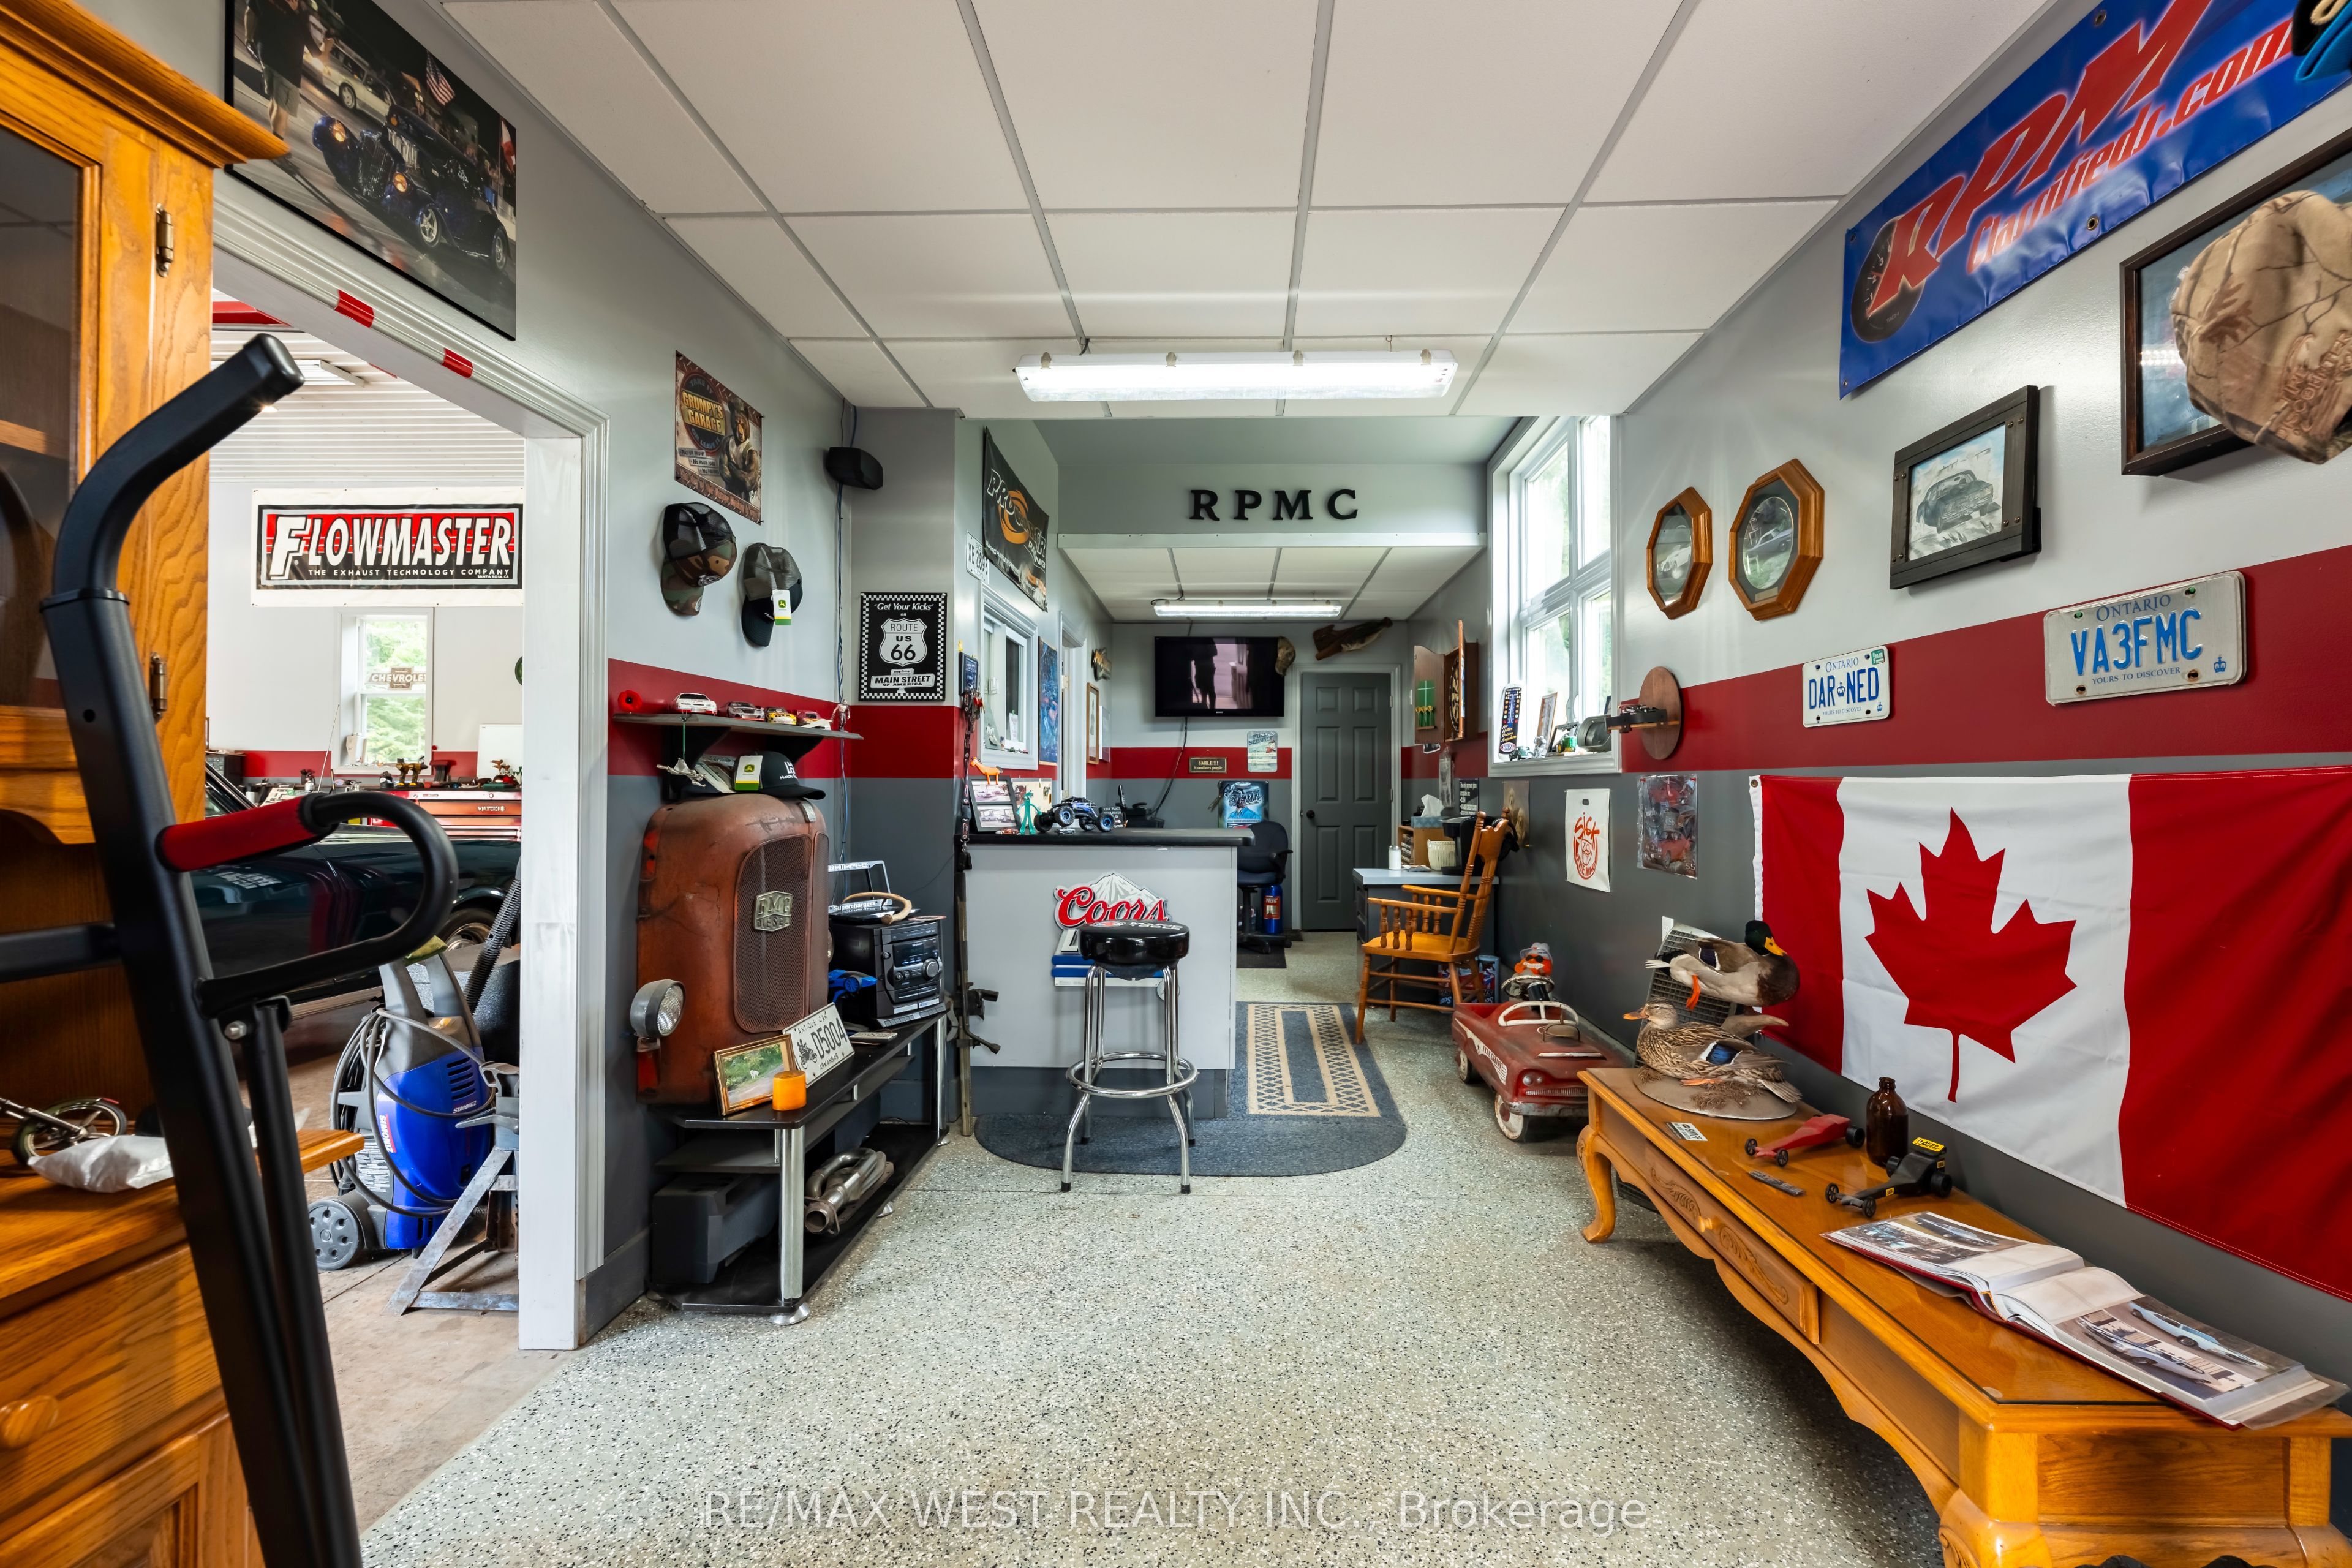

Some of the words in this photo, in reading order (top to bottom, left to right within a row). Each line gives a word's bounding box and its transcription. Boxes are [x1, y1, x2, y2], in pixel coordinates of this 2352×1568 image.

[1867, 0, 2210, 315] RPM
[682, 391, 723, 419] GRUMPY'S
[688, 409, 722, 434] GARAGE
[270, 516, 511, 578] FLOWMASTER
[2096, 594, 2171, 622] ONTARIO
[890, 623, 918, 631] ROUTE
[2070, 606, 2204, 676] VA3FMC
[891, 644, 916, 661] 66
[1825, 657, 1858, 673] ONTARIO
[2092, 674, 2119, 685] YOURS
[2136, 666, 2180, 679] DISCOVER
[372, 674, 426, 682] CHEVROLET
[1809, 675, 1835, 709] DAR
[1847, 667, 1879, 704] NED
[1248, 736, 1274, 745] SERVICE
[758, 895, 790, 915] GMC
[834, 901, 875, 912] Superchargers
[1058, 886, 1169, 927] Coors
[756, 916, 790, 929] DIESEL
[798, 1019, 816, 1034] ANTIQUE
[818, 1012, 827, 1022] CAR
[811, 1017, 847, 1059] D5004
[820, 1053, 839, 1070] ARKANSAS
[453, 1101, 477, 1114] SIMONIZ
[379, 1115, 393, 1153] SIMONIZ
